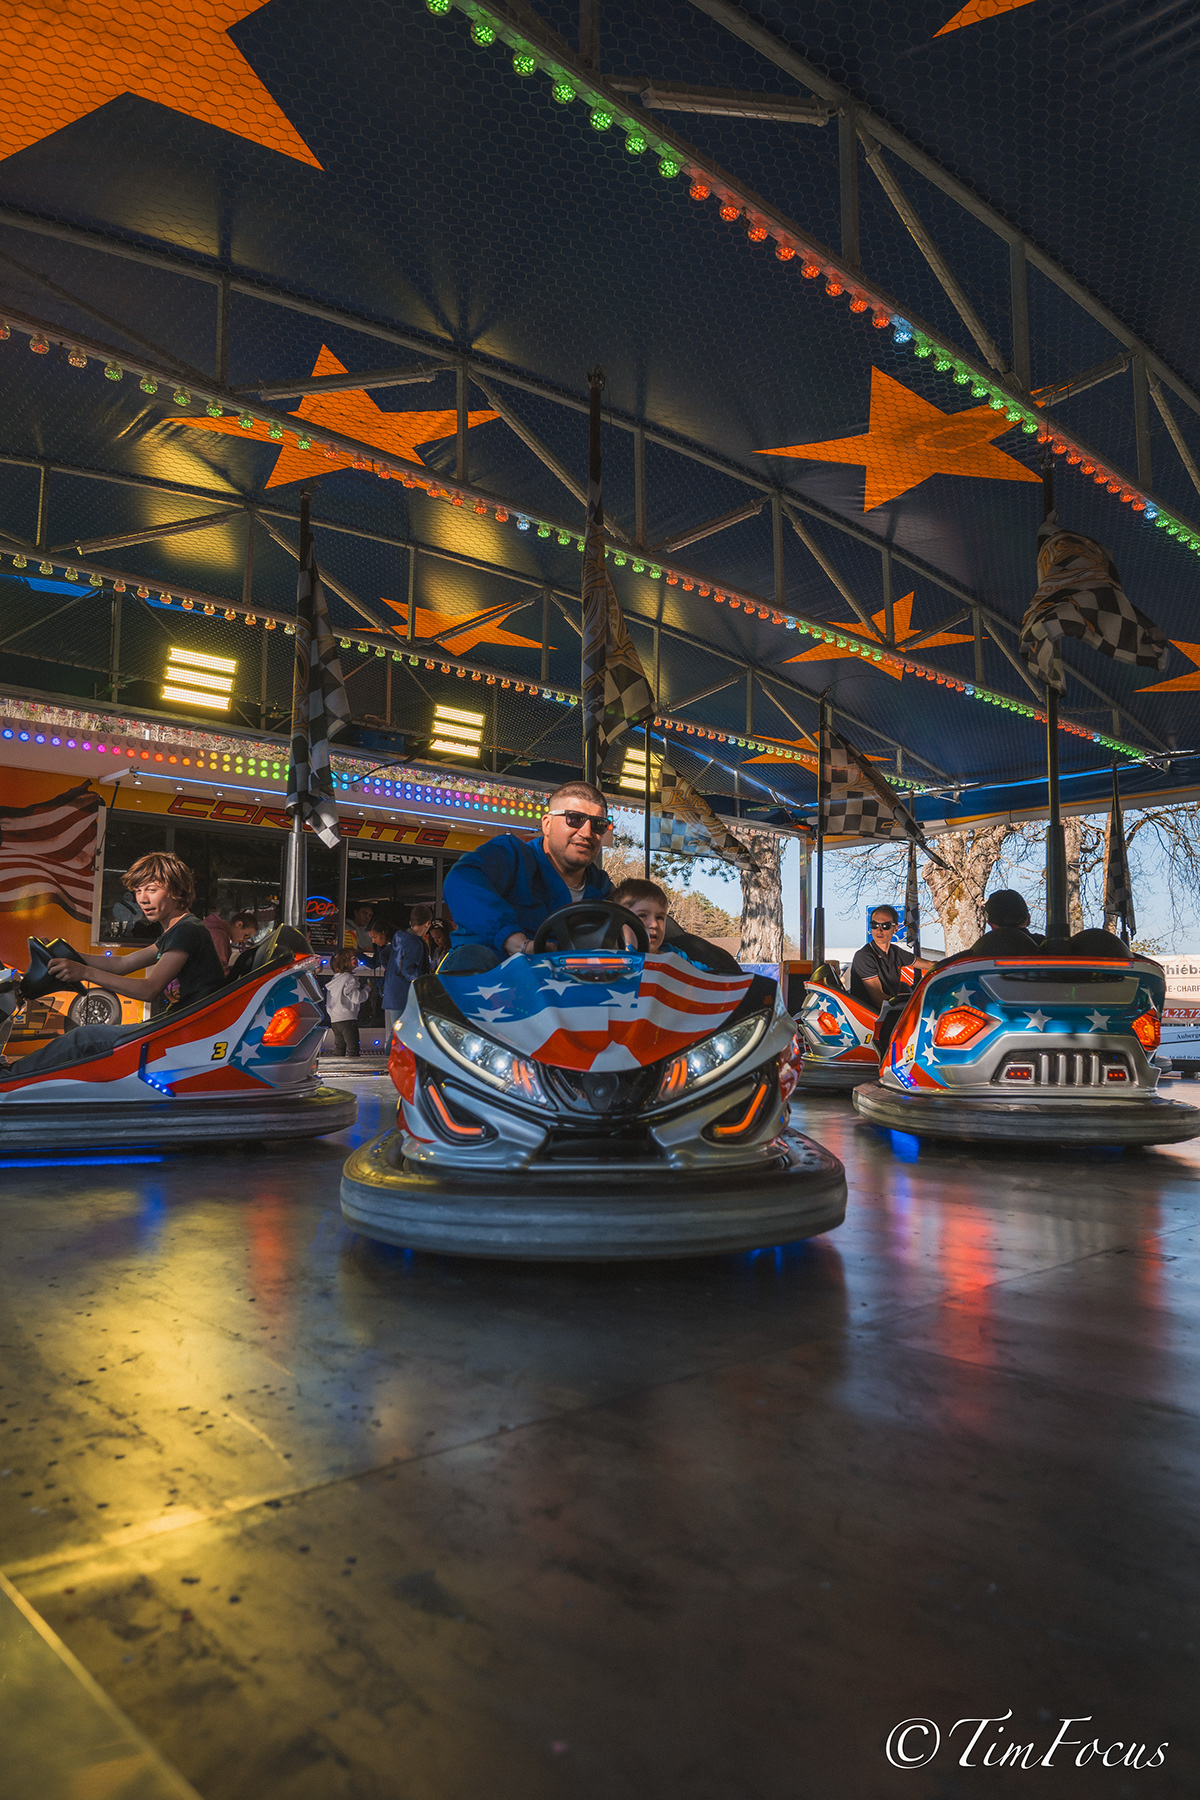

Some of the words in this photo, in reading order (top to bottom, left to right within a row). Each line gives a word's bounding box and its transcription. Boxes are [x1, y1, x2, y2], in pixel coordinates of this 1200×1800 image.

[168, 794, 450, 847] CORETTE
[356, 851, 428, 865] CHEVY
[306, 900, 336, 916] pen
[1163, 964, 1200, 975] hiéb
[1162, 1009, 1200, 1018] 1.22.72
[864, 1033, 872, 1044] 1
[211, 1041, 228, 1061] 3
